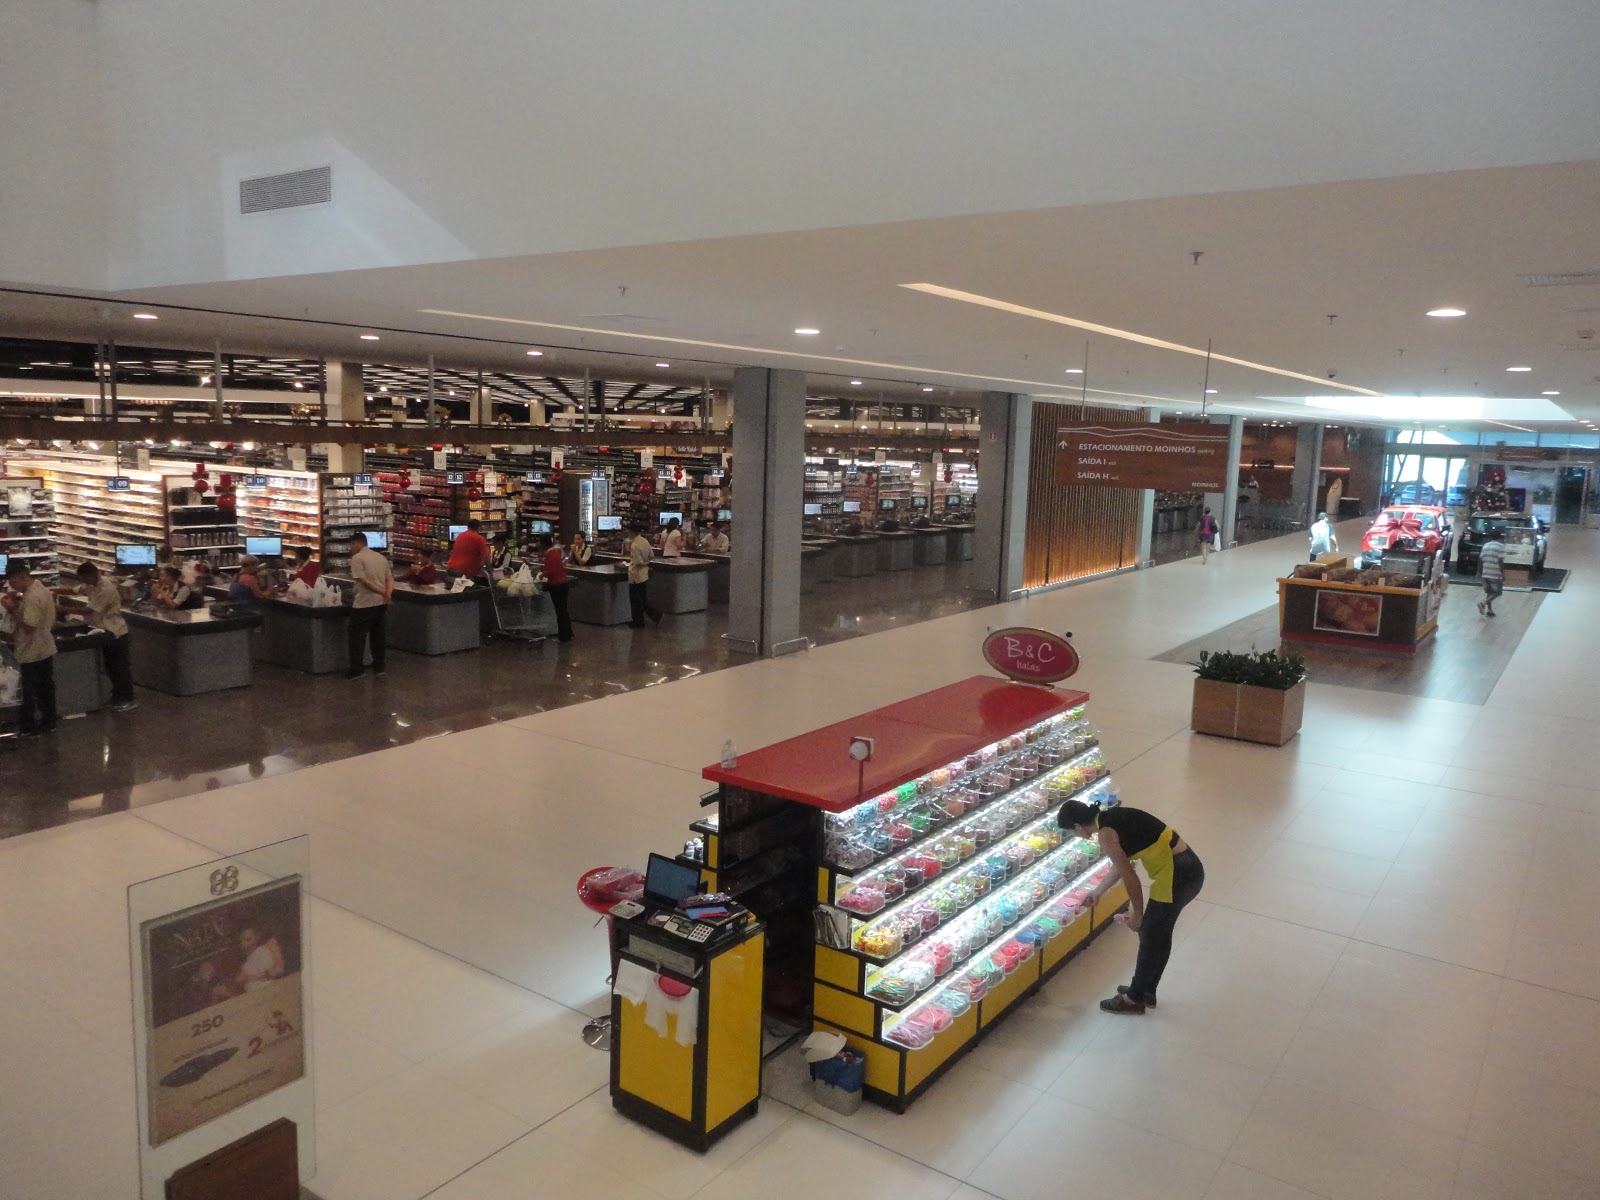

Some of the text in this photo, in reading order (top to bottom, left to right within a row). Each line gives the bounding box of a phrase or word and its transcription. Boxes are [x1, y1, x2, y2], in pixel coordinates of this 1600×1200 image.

[1078, 443, 1153, 453] ESTACIONAMENTO
[1154, 445, 1196, 454] MOINHOS
[1077, 457, 1102, 465] SAÍDA
[1077, 471, 1101, 480] SAÍDA
[1102, 472, 1109, 480] H
[191, 1014, 224, 1037] 250
[246, 1036, 263, 1059] 2
